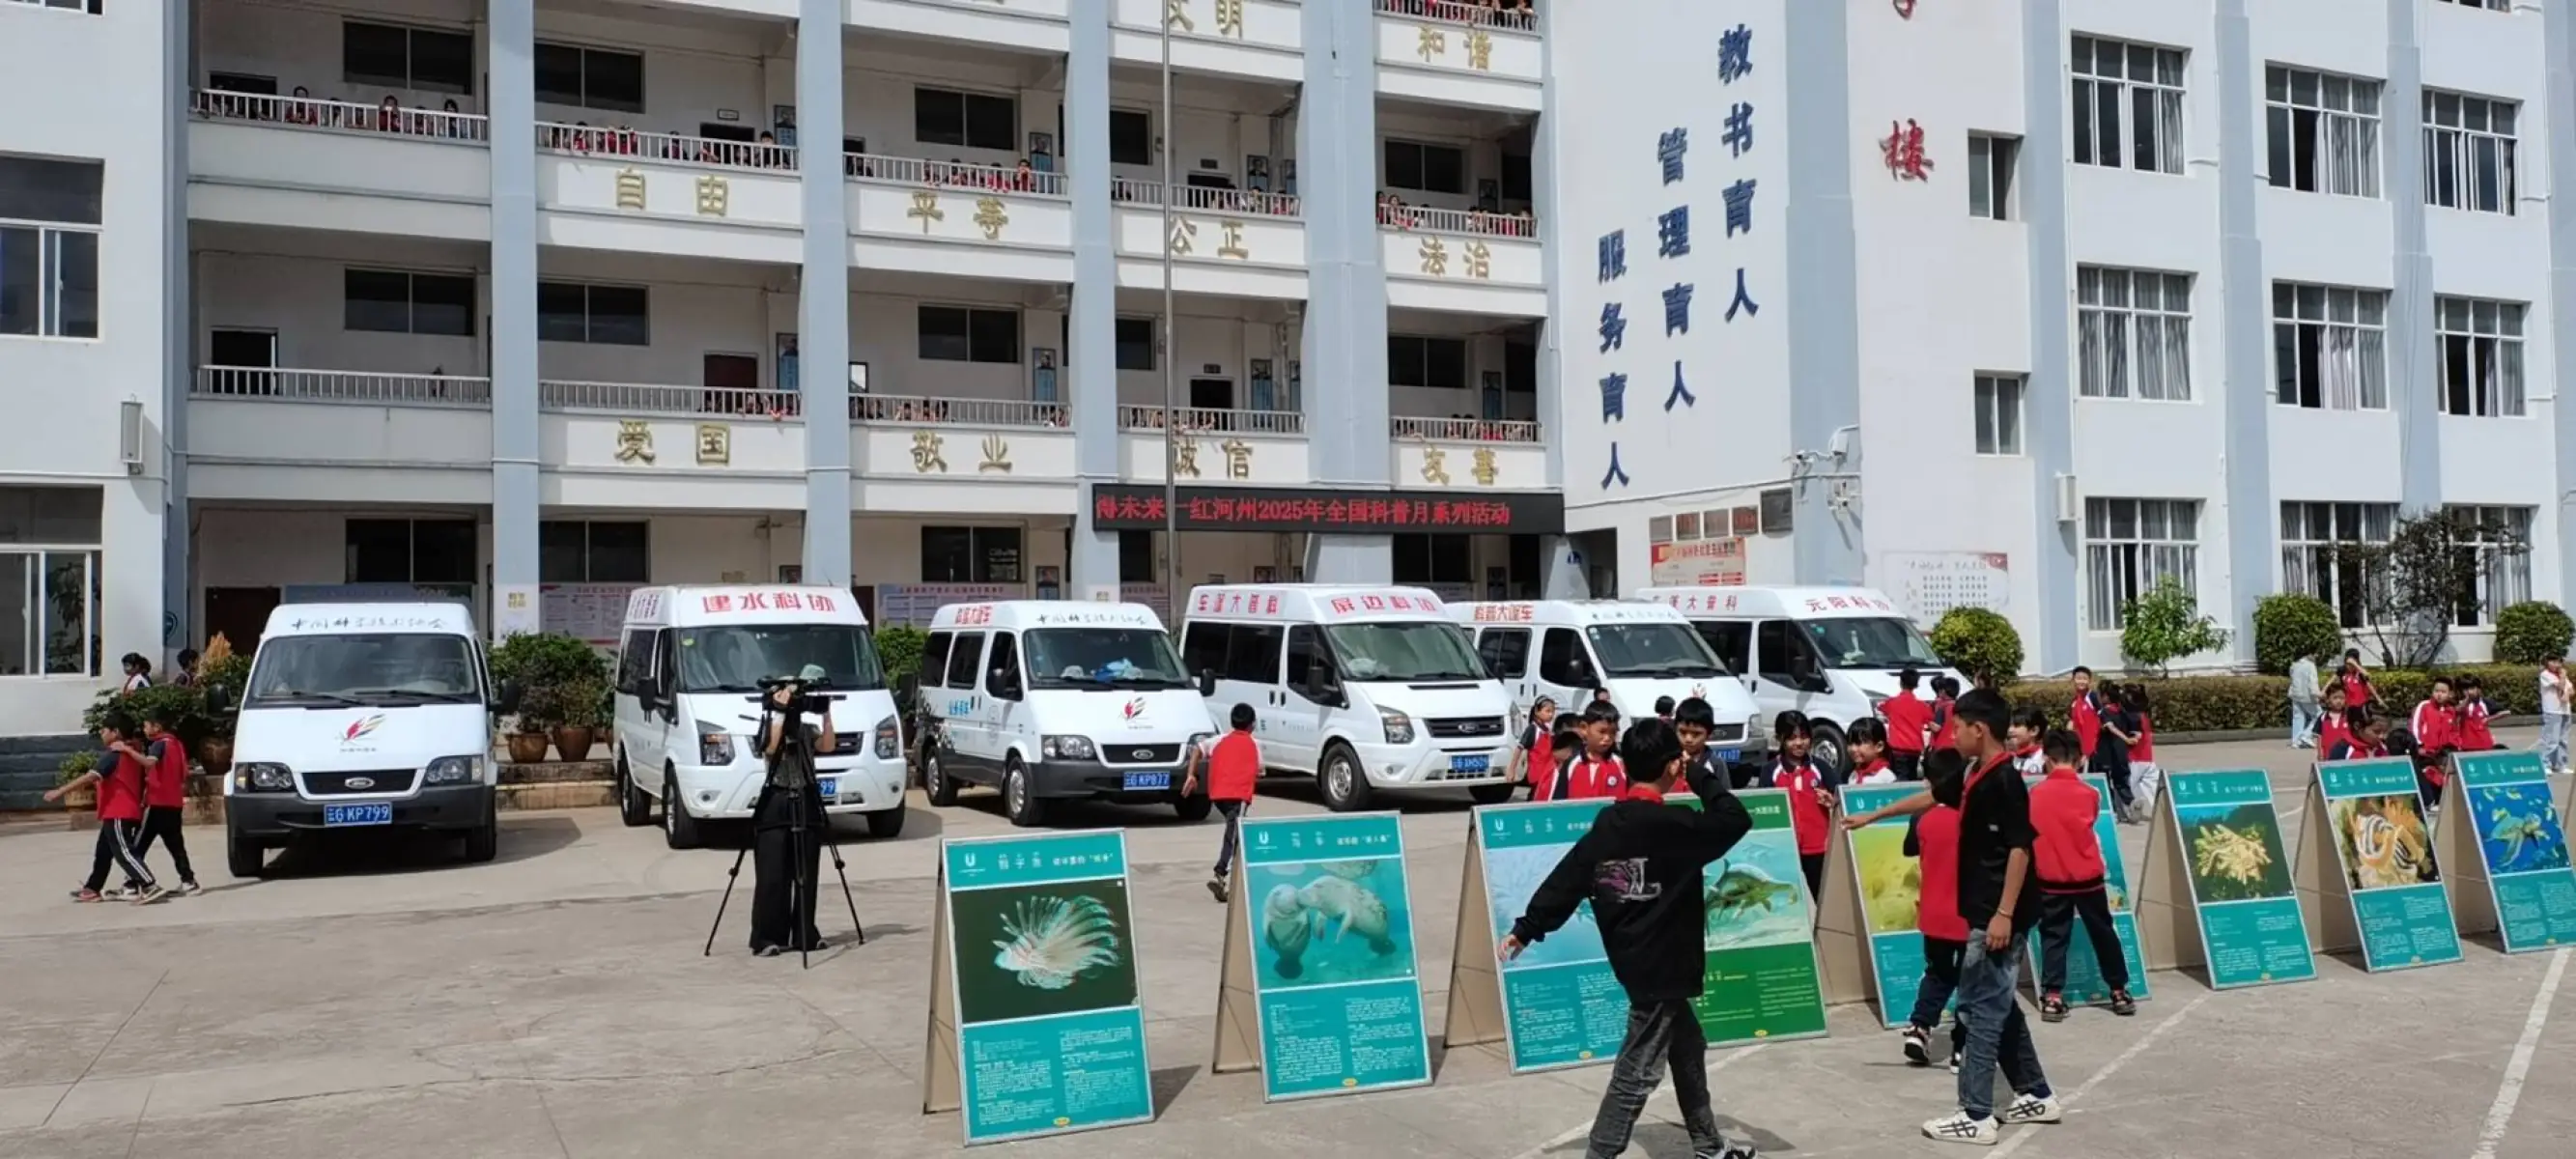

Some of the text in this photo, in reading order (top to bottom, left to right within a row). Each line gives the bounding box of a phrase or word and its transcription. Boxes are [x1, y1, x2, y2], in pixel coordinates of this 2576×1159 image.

[1417, 23, 1492, 69] 和谐
[615, 166, 728, 216] 自由
[1717, 23, 1759, 323] 教书育人
[907, 190, 1009, 240] 平等
[1169, 215, 1248, 259] 公正
[1419, 235, 1490, 278] 法治
[1657, 127, 1696, 412] 管理育人
[1598, 228, 1630, 491] 服务育人
[613, 419, 731, 466] 爱国
[911, 429, 1012, 473] 敬业
[1421, 443, 1498, 485] 友善
[702, 592, 835, 613] 建水科协
